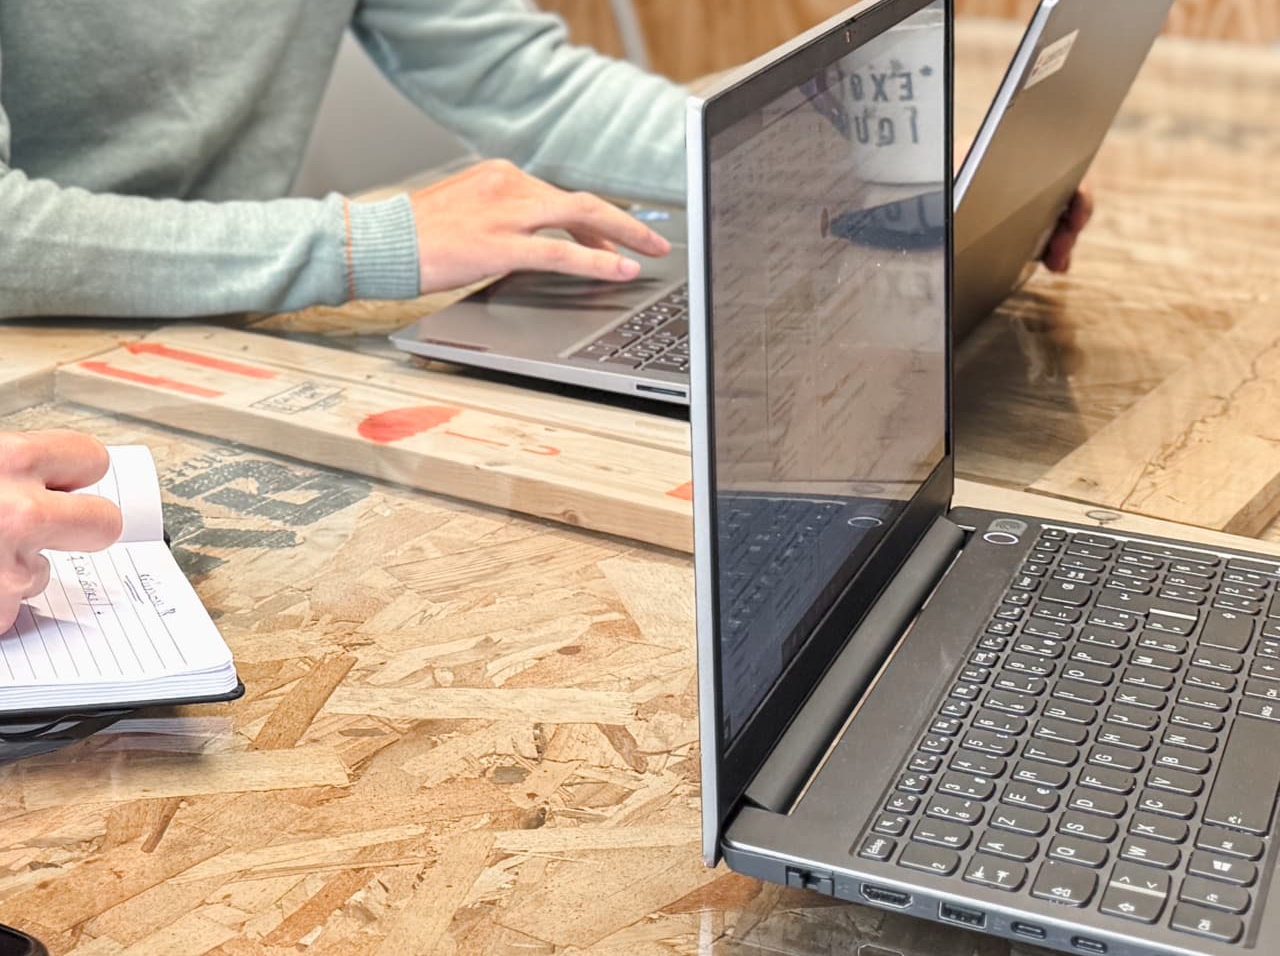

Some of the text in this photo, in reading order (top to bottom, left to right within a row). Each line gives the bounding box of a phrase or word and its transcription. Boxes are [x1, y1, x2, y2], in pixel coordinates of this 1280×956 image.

[1077, 651, 1092, 659] P
[1068, 669, 1085, 677] O
[1120, 693, 1137, 702] K
[1112, 714, 1129, 722] J
[1040, 727, 1057, 735] Y
[1103, 733, 1120, 742] H
[1169, 734, 1187, 743] N
[1095, 754, 1112, 762] G
[1162, 756, 1179, 764] B
[1020, 770, 1037, 779] R
[1085, 776, 1102, 784] F
[1153, 777, 1170, 785] V
[1009, 793, 1026, 802] E
[1076, 798, 1094, 808] D
[1145, 799, 1163, 809] C
[933, 807, 949, 815] 2
[997, 816, 1015, 826] Z
[1067, 822, 1084, 832] S
[1136, 824, 1156, 834] X
[987, 843, 1004, 851] A
[1057, 846, 1075, 856] Q
[1128, 845, 1147, 856] W
